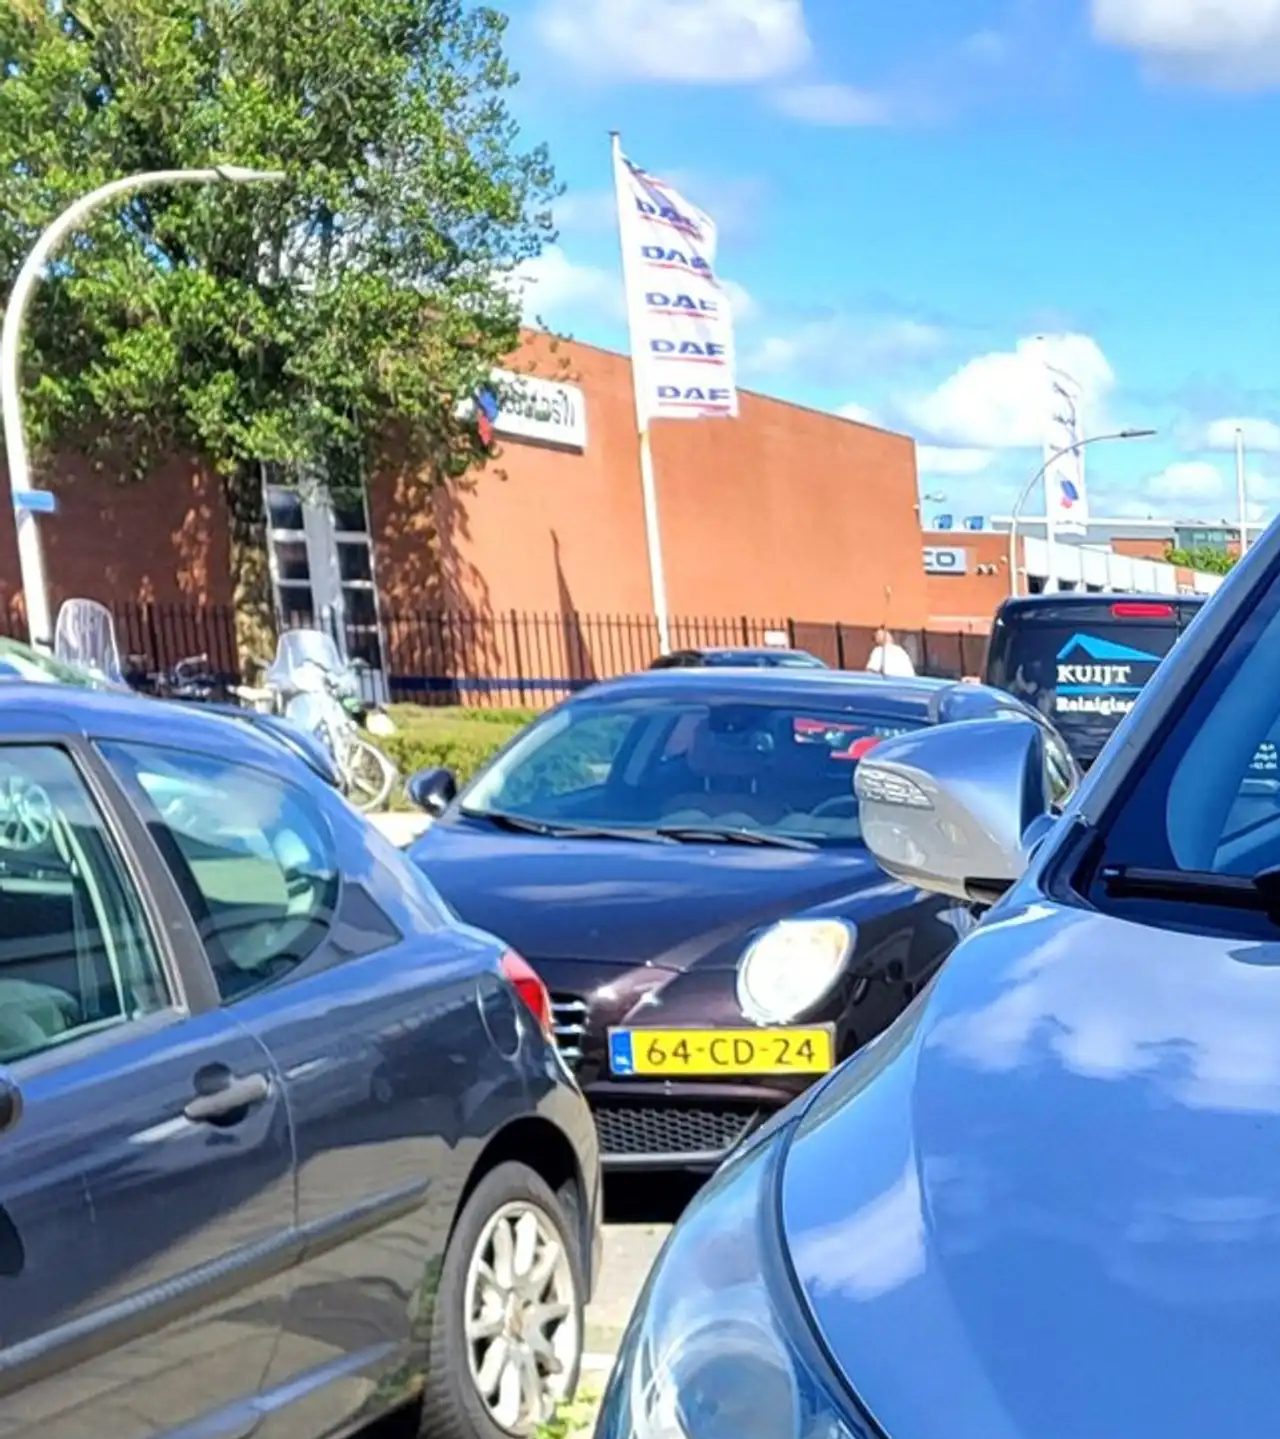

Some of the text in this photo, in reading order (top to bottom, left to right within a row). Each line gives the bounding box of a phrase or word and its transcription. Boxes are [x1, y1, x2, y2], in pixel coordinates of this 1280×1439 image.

[650, 339, 725, 356] DAF
[657, 386, 730, 400] DAF
[1056, 664, 1132, 686] KUIJT
[646, 1038, 815, 1065] 64-CD-24
